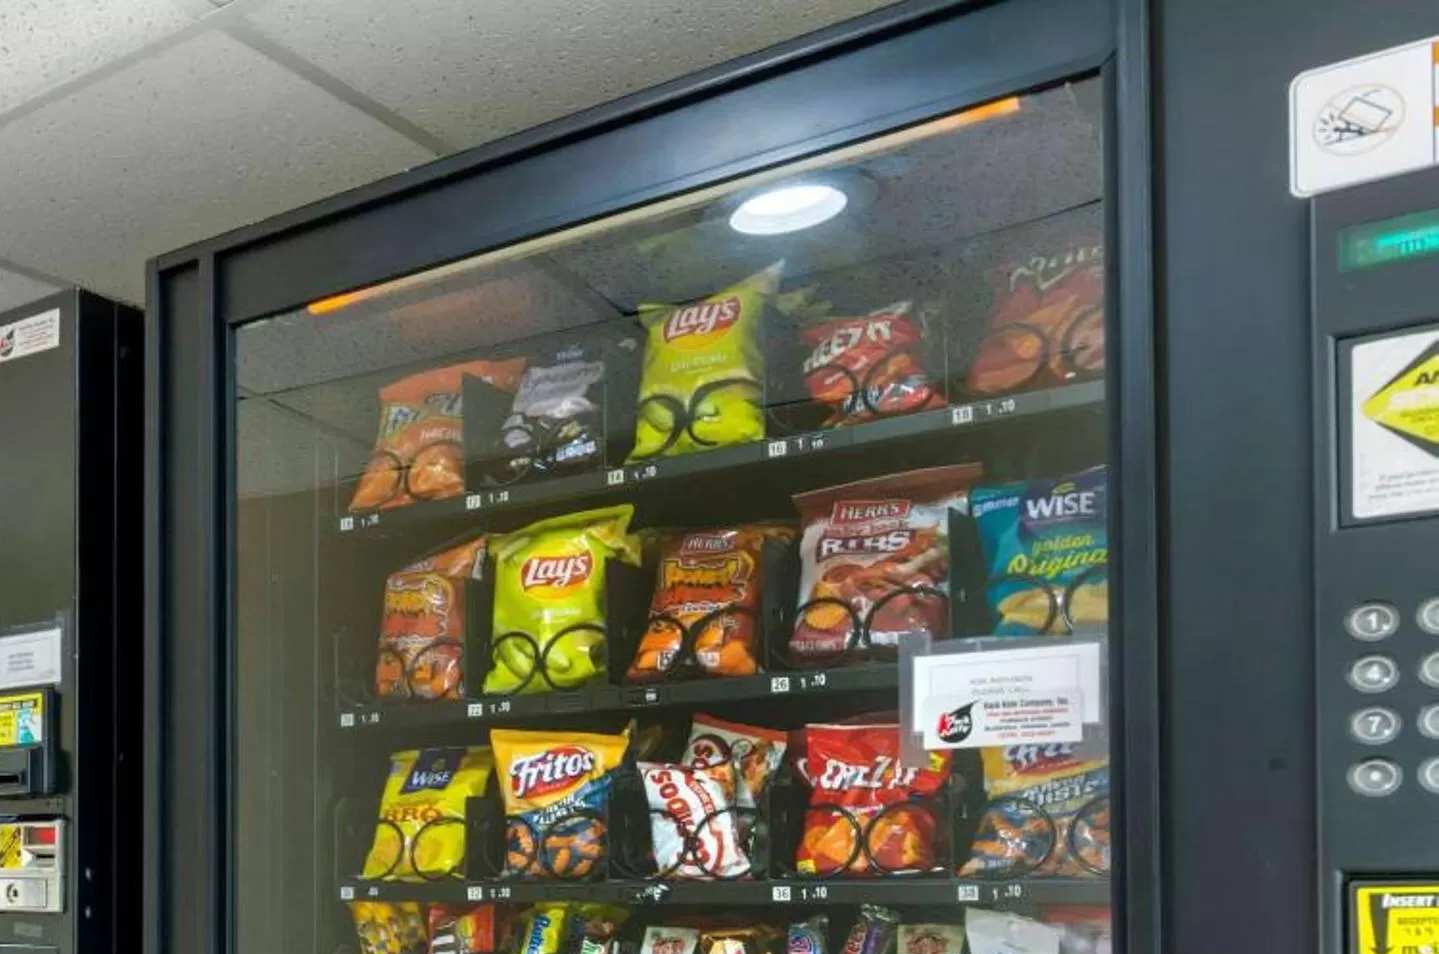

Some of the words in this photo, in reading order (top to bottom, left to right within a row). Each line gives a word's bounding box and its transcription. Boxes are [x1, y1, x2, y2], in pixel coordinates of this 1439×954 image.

[1027, 493, 1094, 520] WISE
[1367, 611, 1379, 631] 1
[1367, 663, 1381, 681] 4
[1367, 715, 1381, 733] 7
[509, 750, 595, 799] Fritos
